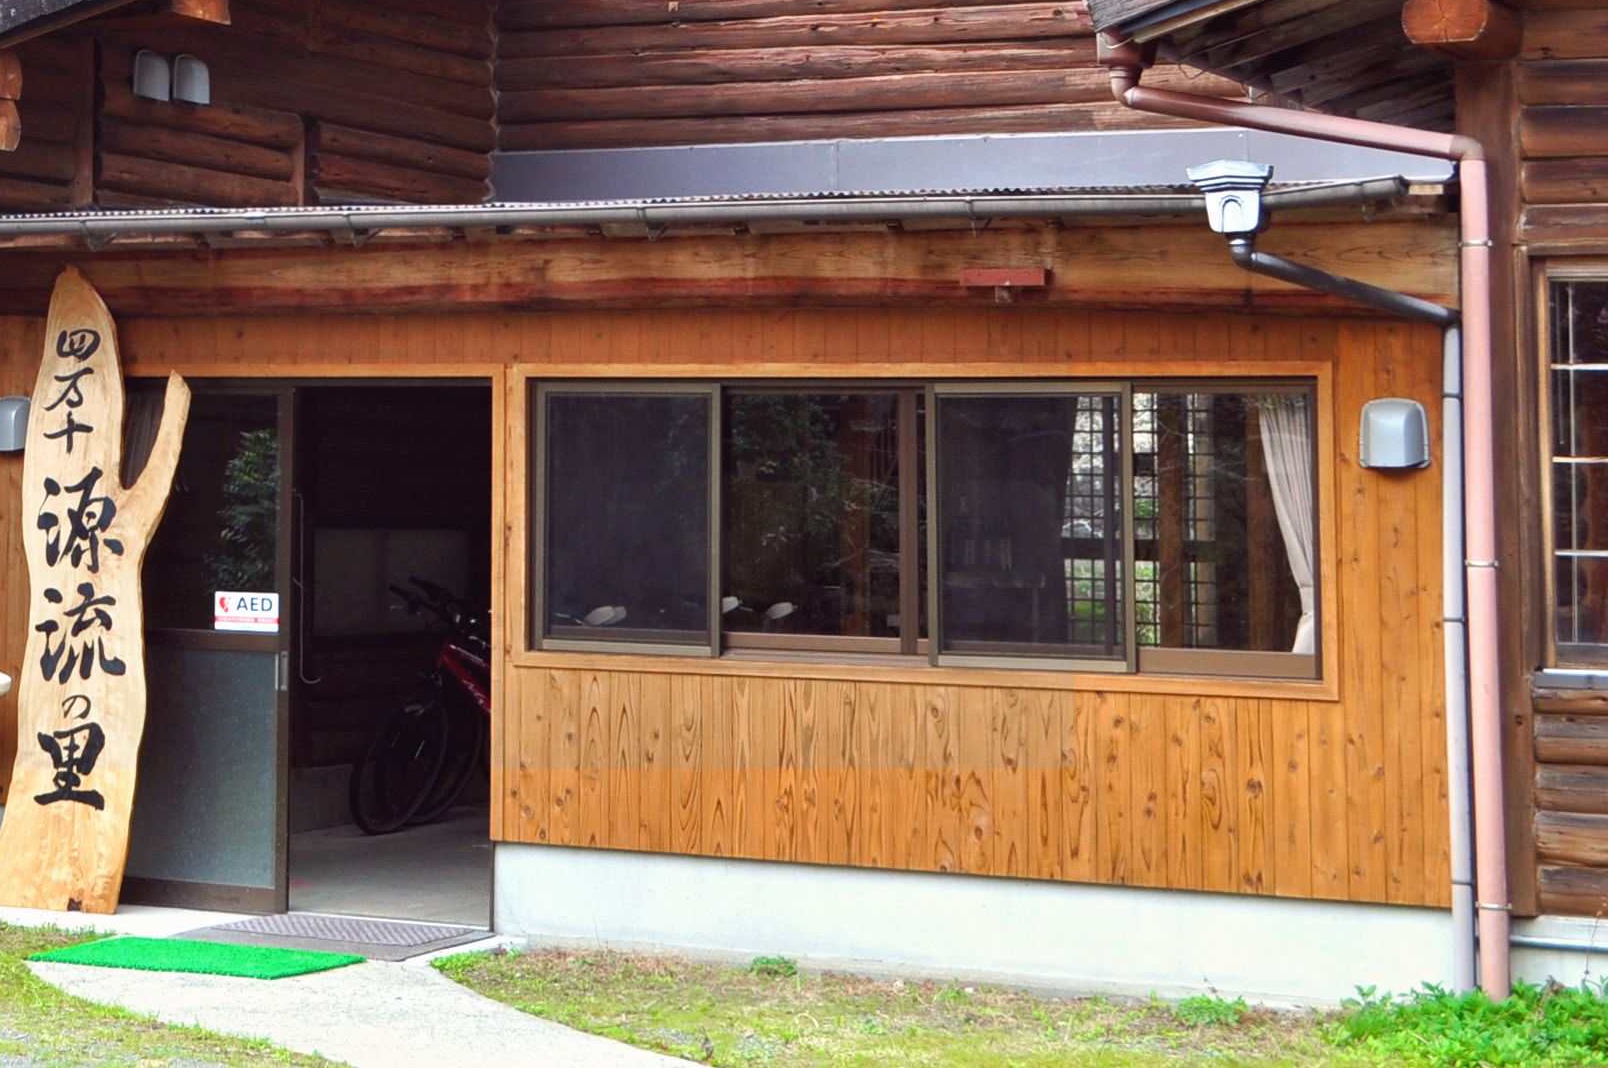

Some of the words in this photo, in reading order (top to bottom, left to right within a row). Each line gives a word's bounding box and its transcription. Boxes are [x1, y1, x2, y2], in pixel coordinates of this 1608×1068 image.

[33, 328, 126, 811] 四万十源流の里
[236, 596, 273, 612] AED
